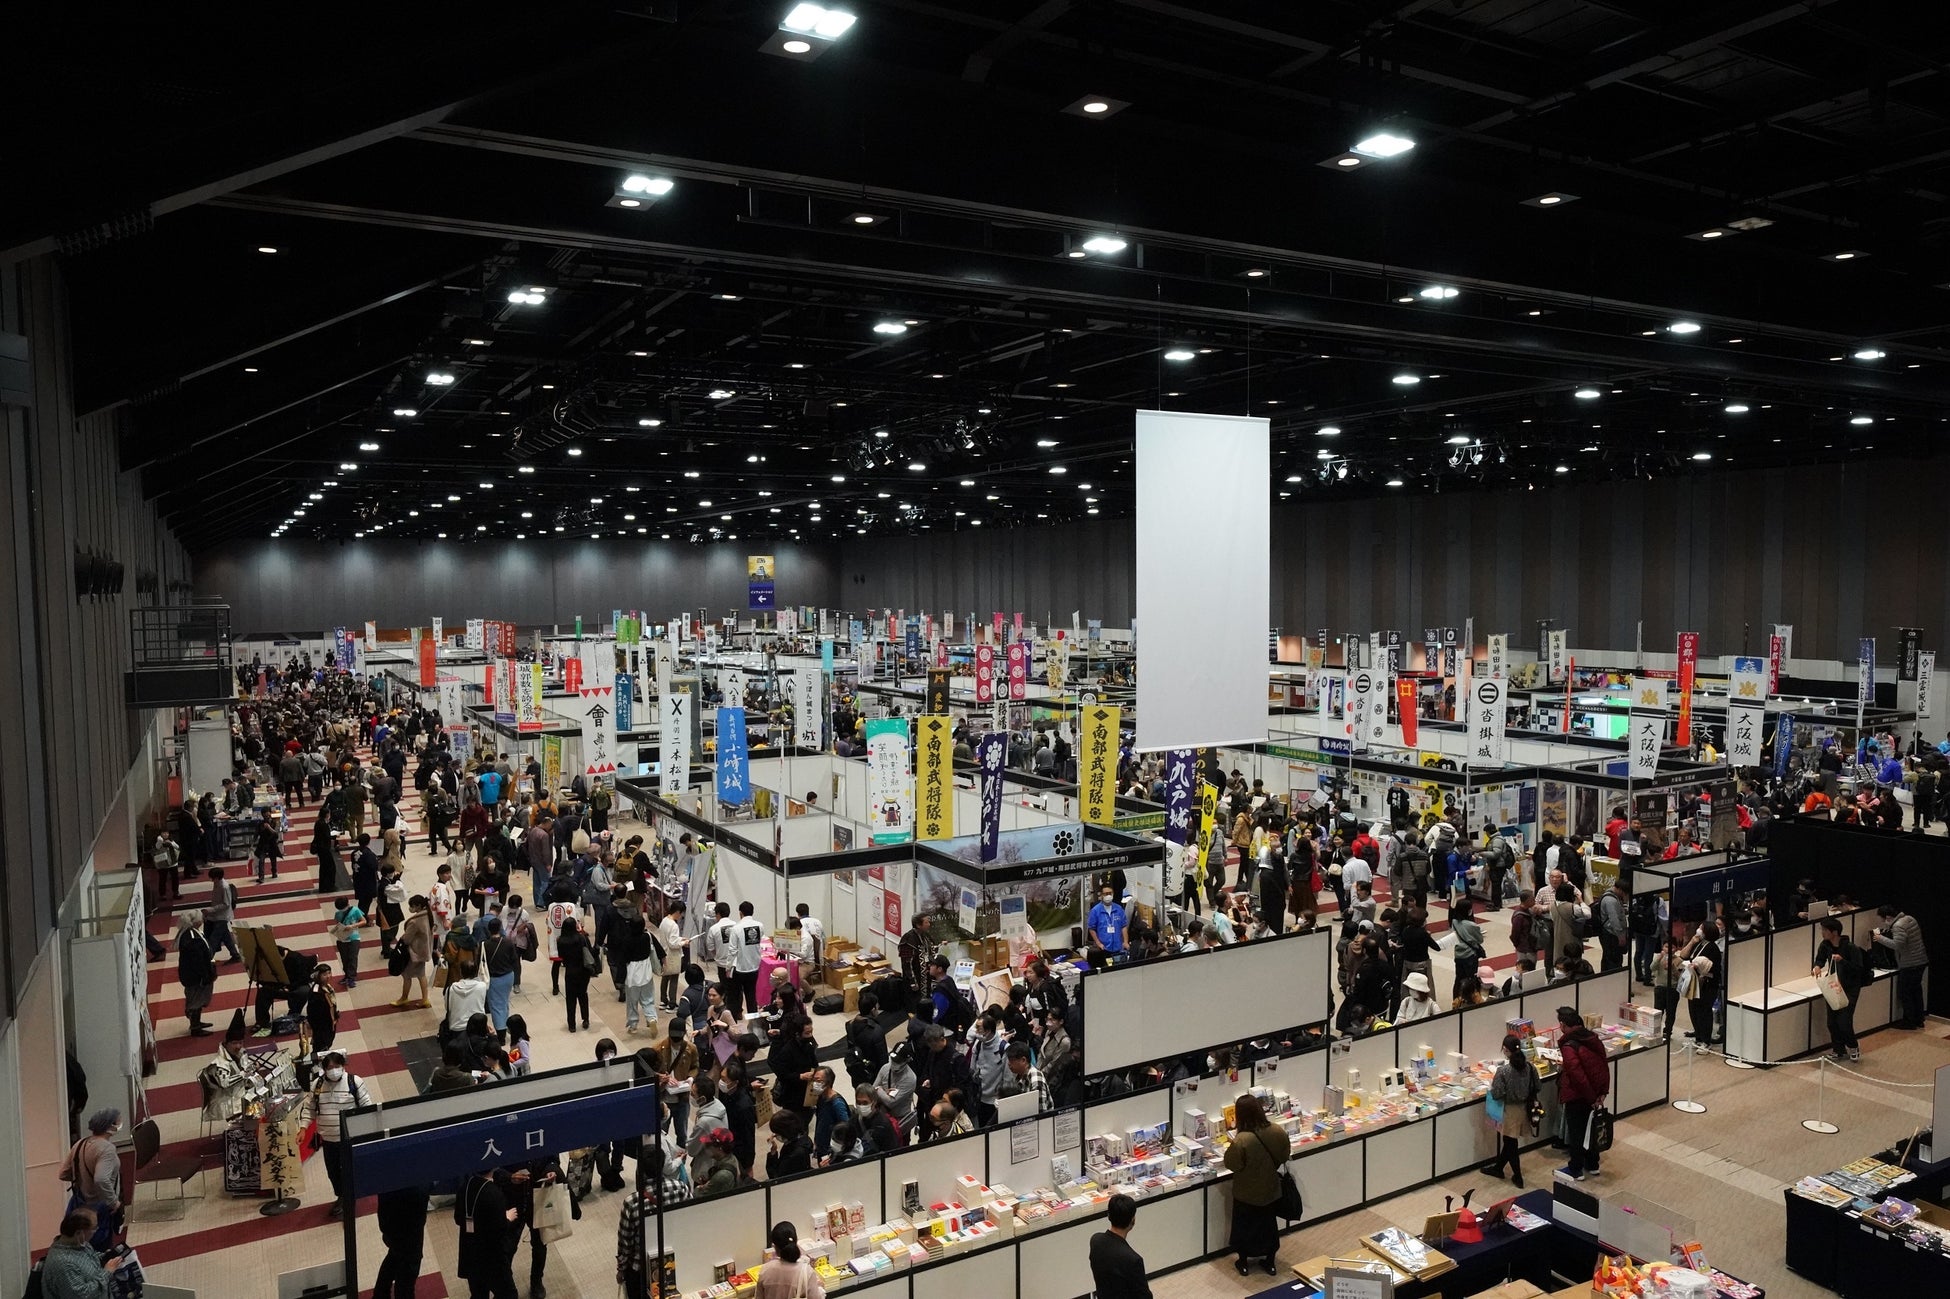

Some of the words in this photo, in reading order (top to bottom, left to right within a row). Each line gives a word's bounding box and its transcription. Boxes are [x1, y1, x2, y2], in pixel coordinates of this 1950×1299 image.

[1477, 709, 1494, 758] 沓掛城
[1638, 722, 1656, 769] 大阪城
[1734, 712, 1753, 756] 大阪城
[926, 735, 942, 821] 南部武将隊
[1089, 724, 1108, 804] 南部武将隊
[1168, 761, 1190, 829] 九戸城
[1712, 879, 1734, 893] 出口
[481, 1128, 544, 1160] 入口
